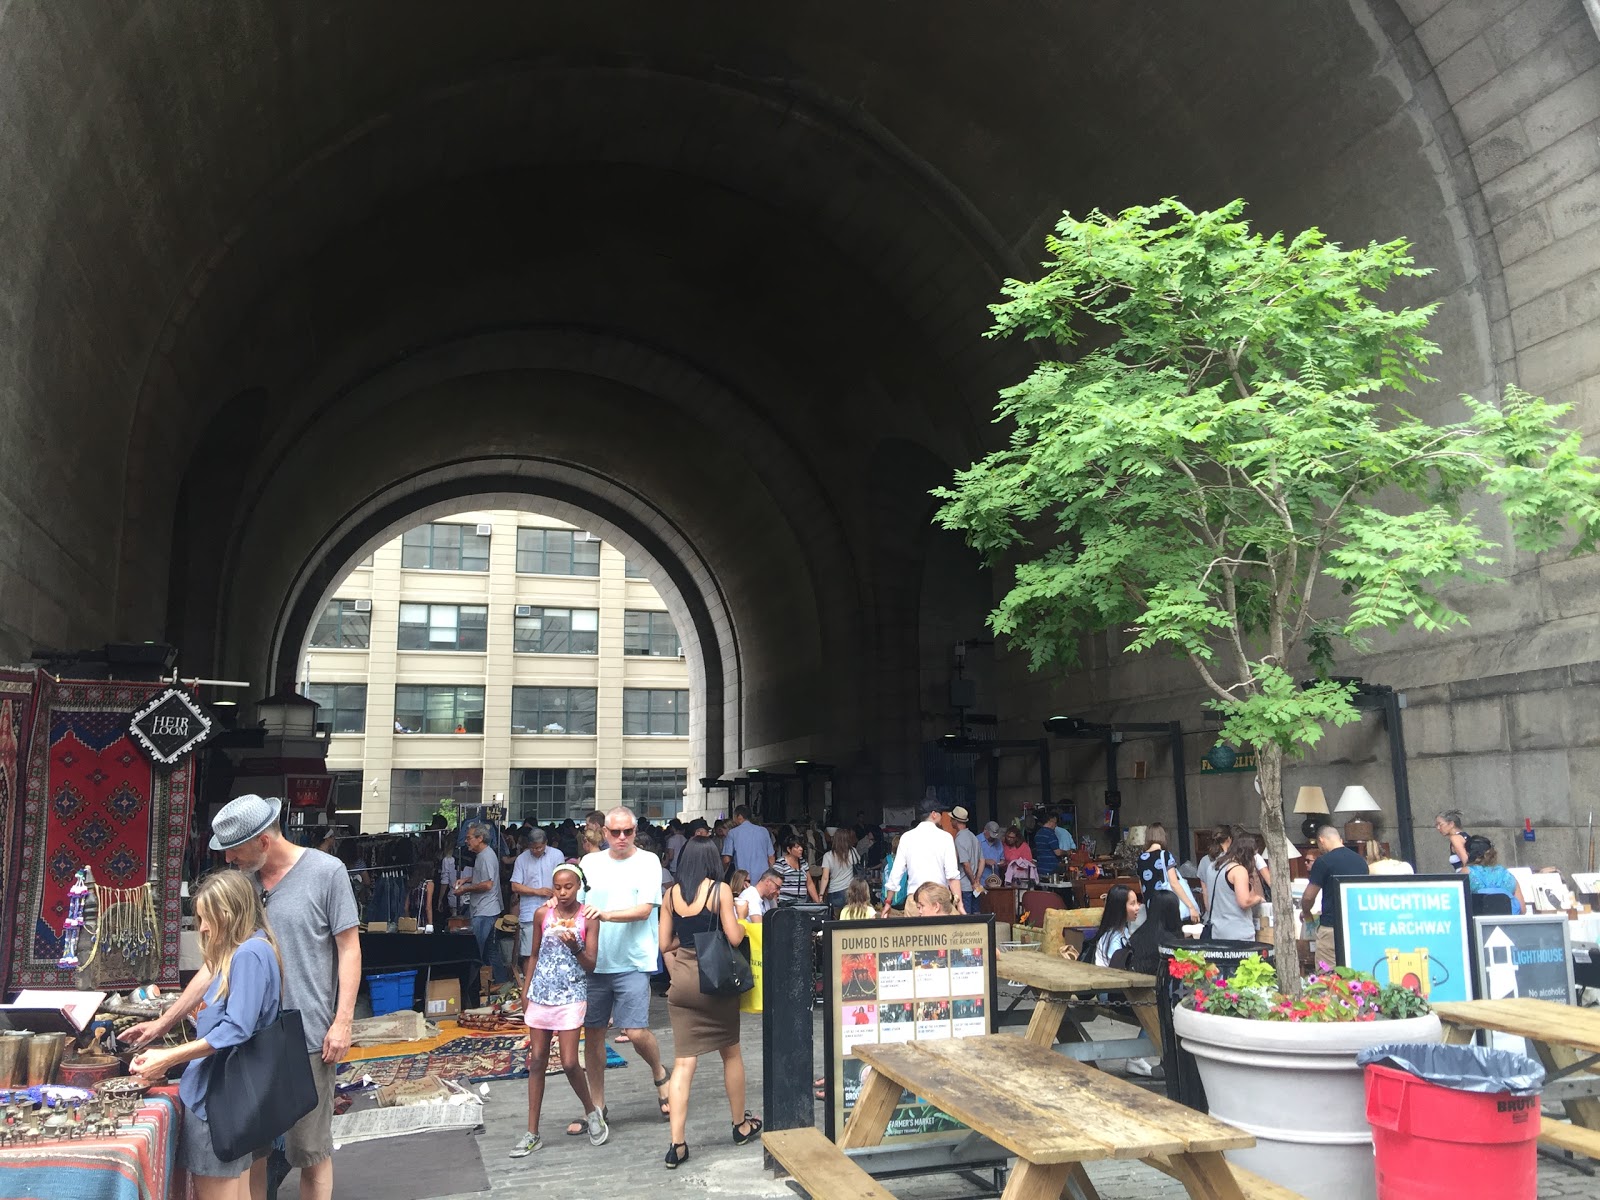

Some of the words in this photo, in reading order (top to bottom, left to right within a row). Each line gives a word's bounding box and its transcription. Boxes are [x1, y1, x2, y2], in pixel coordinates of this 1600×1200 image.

[154, 716, 189, 727] HEIR
[152, 725, 189, 736] LOOM
[1358, 894, 1451, 911] LUNCHTIME
[1360, 921, 1386, 936] THE
[1389, 921, 1452, 935] ARCHWAY
[842, 937, 876, 950] DUMBO
[880, 936, 889, 948] IS
[892, 934, 947, 948] HAPPENING
[1513, 949, 1564, 965] LIGHTHOUSE
[1528, 989, 1538, 997] No
[1539, 987, 1566, 997] alcoholic
[889, 1119, 914, 1128] FARMER'S
[914, 1117, 935, 1126] MARKET
